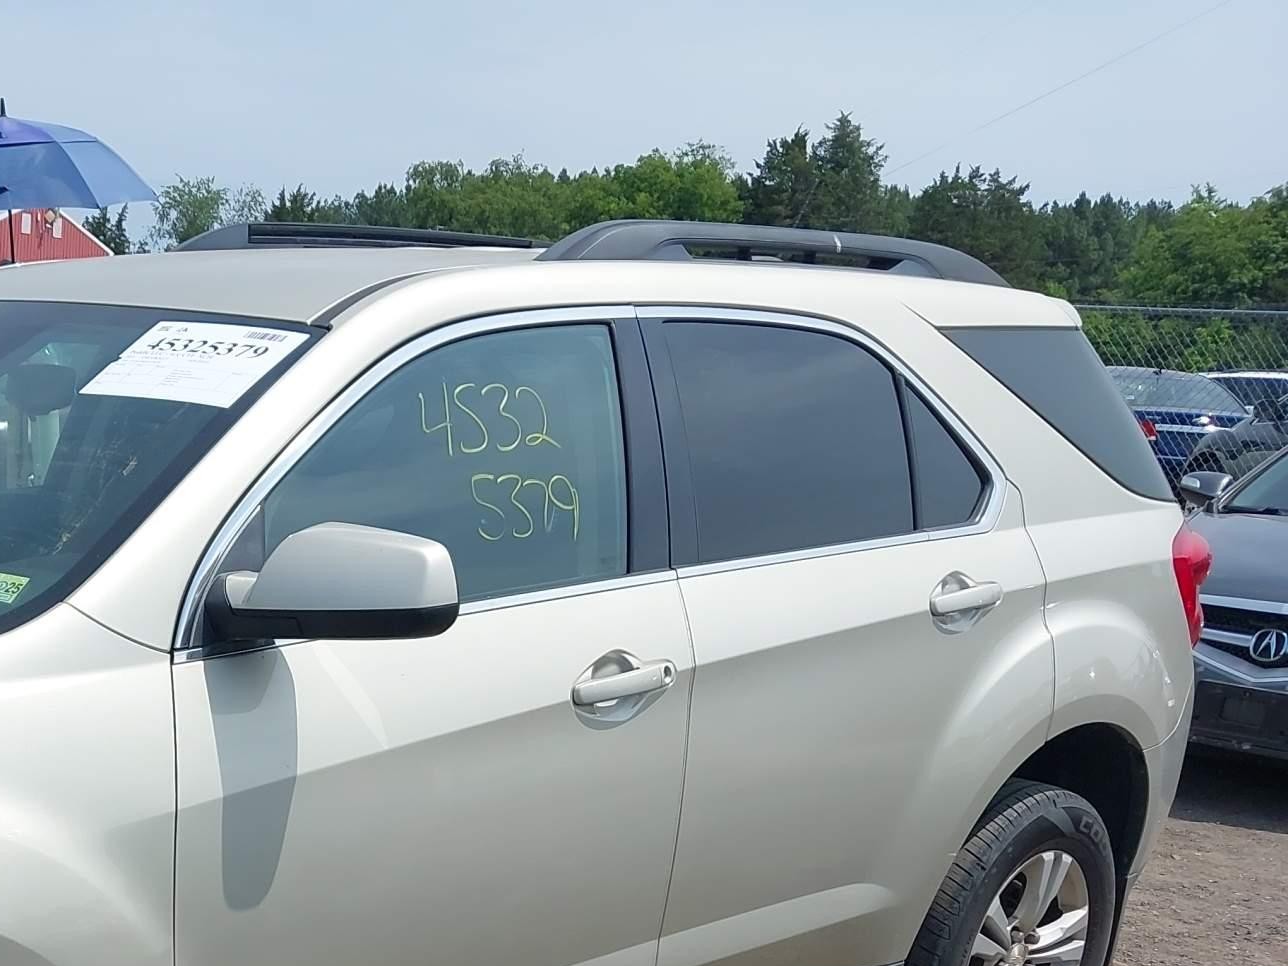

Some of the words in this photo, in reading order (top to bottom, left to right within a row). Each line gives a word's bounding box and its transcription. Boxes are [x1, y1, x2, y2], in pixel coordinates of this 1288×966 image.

[146, 337, 269, 359] 45325379
[418, 378, 561, 456] 4532
[471, 473, 580, 541] 5379
[4, 582, 23, 594] 25
